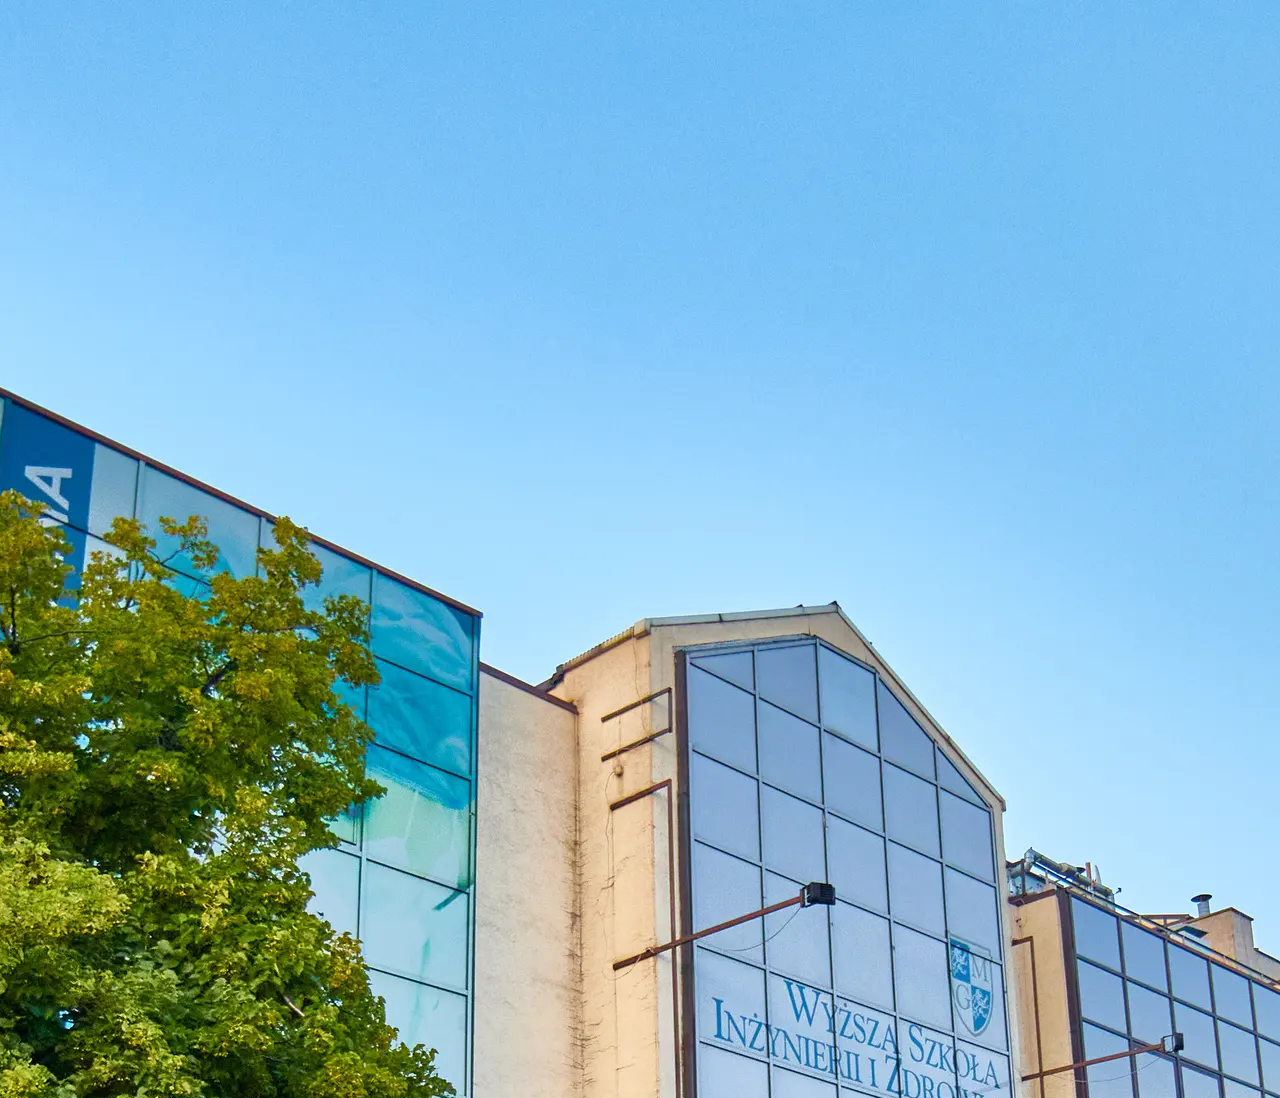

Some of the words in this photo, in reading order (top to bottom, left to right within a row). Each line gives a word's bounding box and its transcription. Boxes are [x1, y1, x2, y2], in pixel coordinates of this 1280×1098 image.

[712, 996, 862, 1084] INŻYNIERII
[784, 979, 901, 1053] WYŻSZA
[908, 1023, 1000, 1089] SZKOŁA
